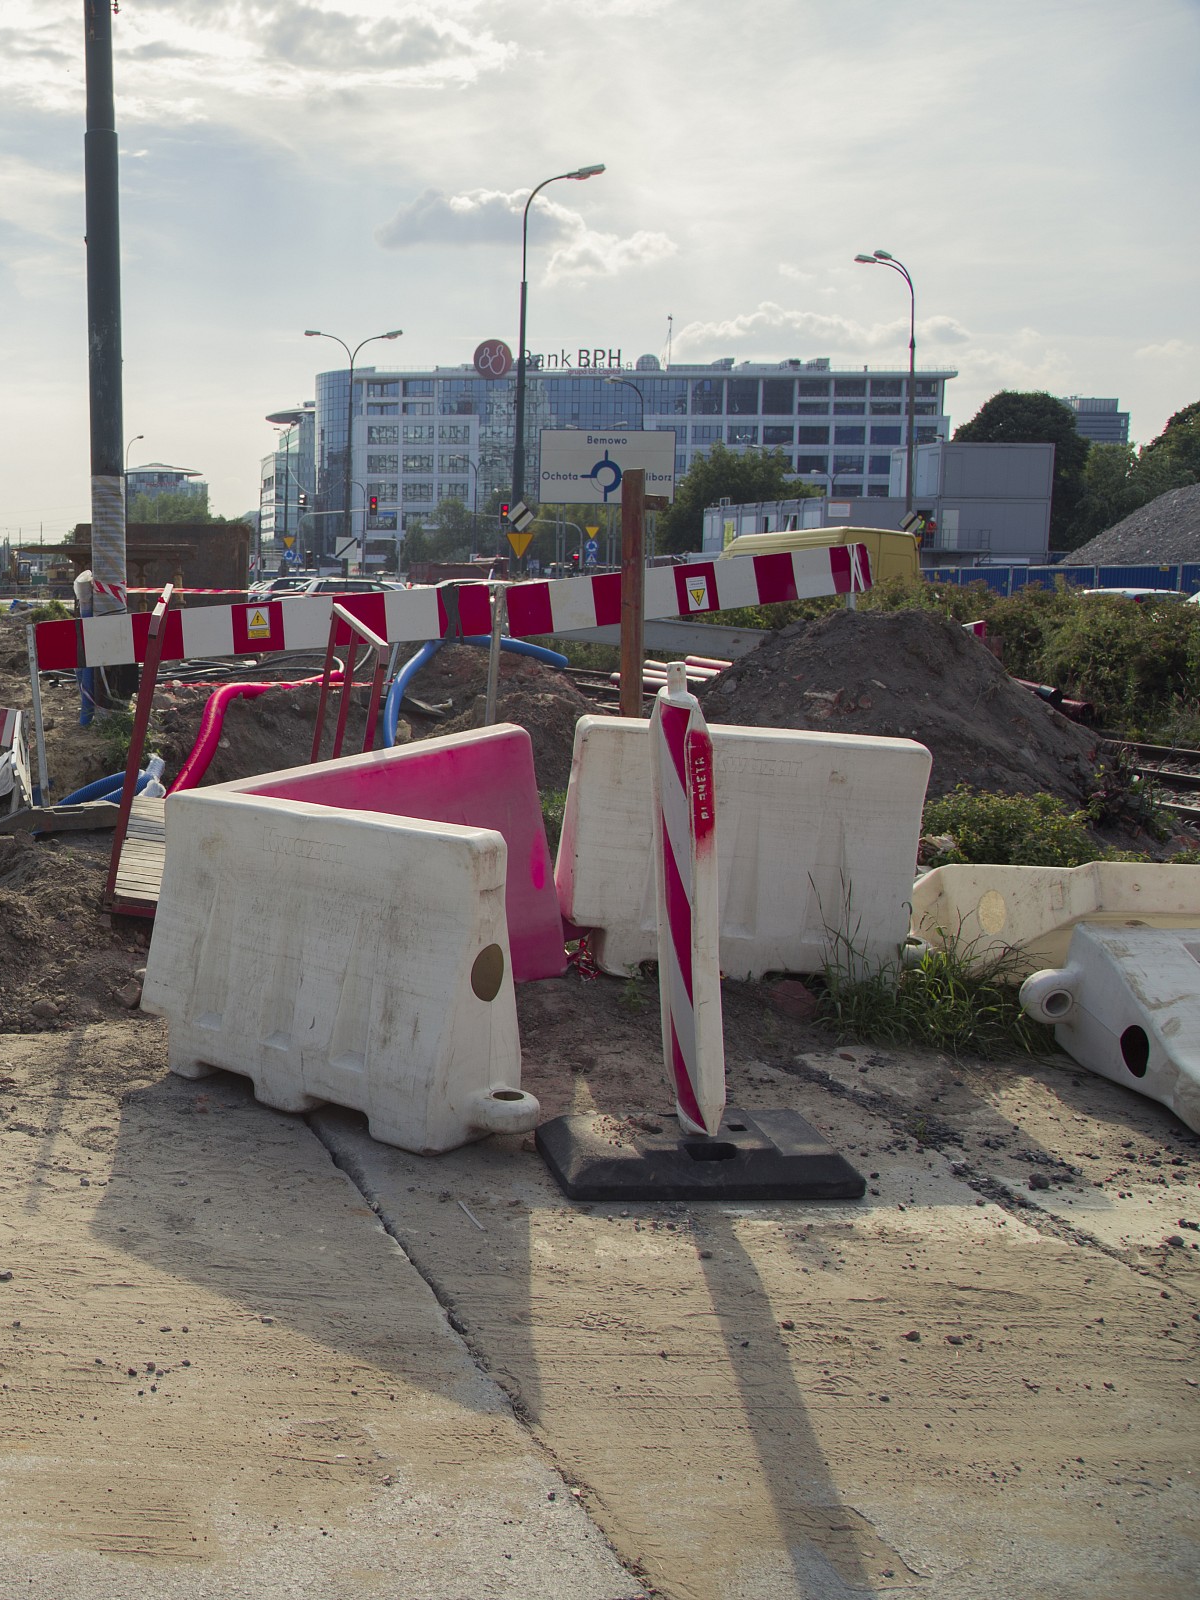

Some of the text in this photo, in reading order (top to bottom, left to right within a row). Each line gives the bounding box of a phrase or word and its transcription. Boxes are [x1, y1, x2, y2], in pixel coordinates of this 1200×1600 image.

[523, 348, 572, 368] Bank
[578, 348, 622, 368] BPH
[586, 435, 628, 445] Bemowo
[541, 471, 673, 482] Ochota liborz
